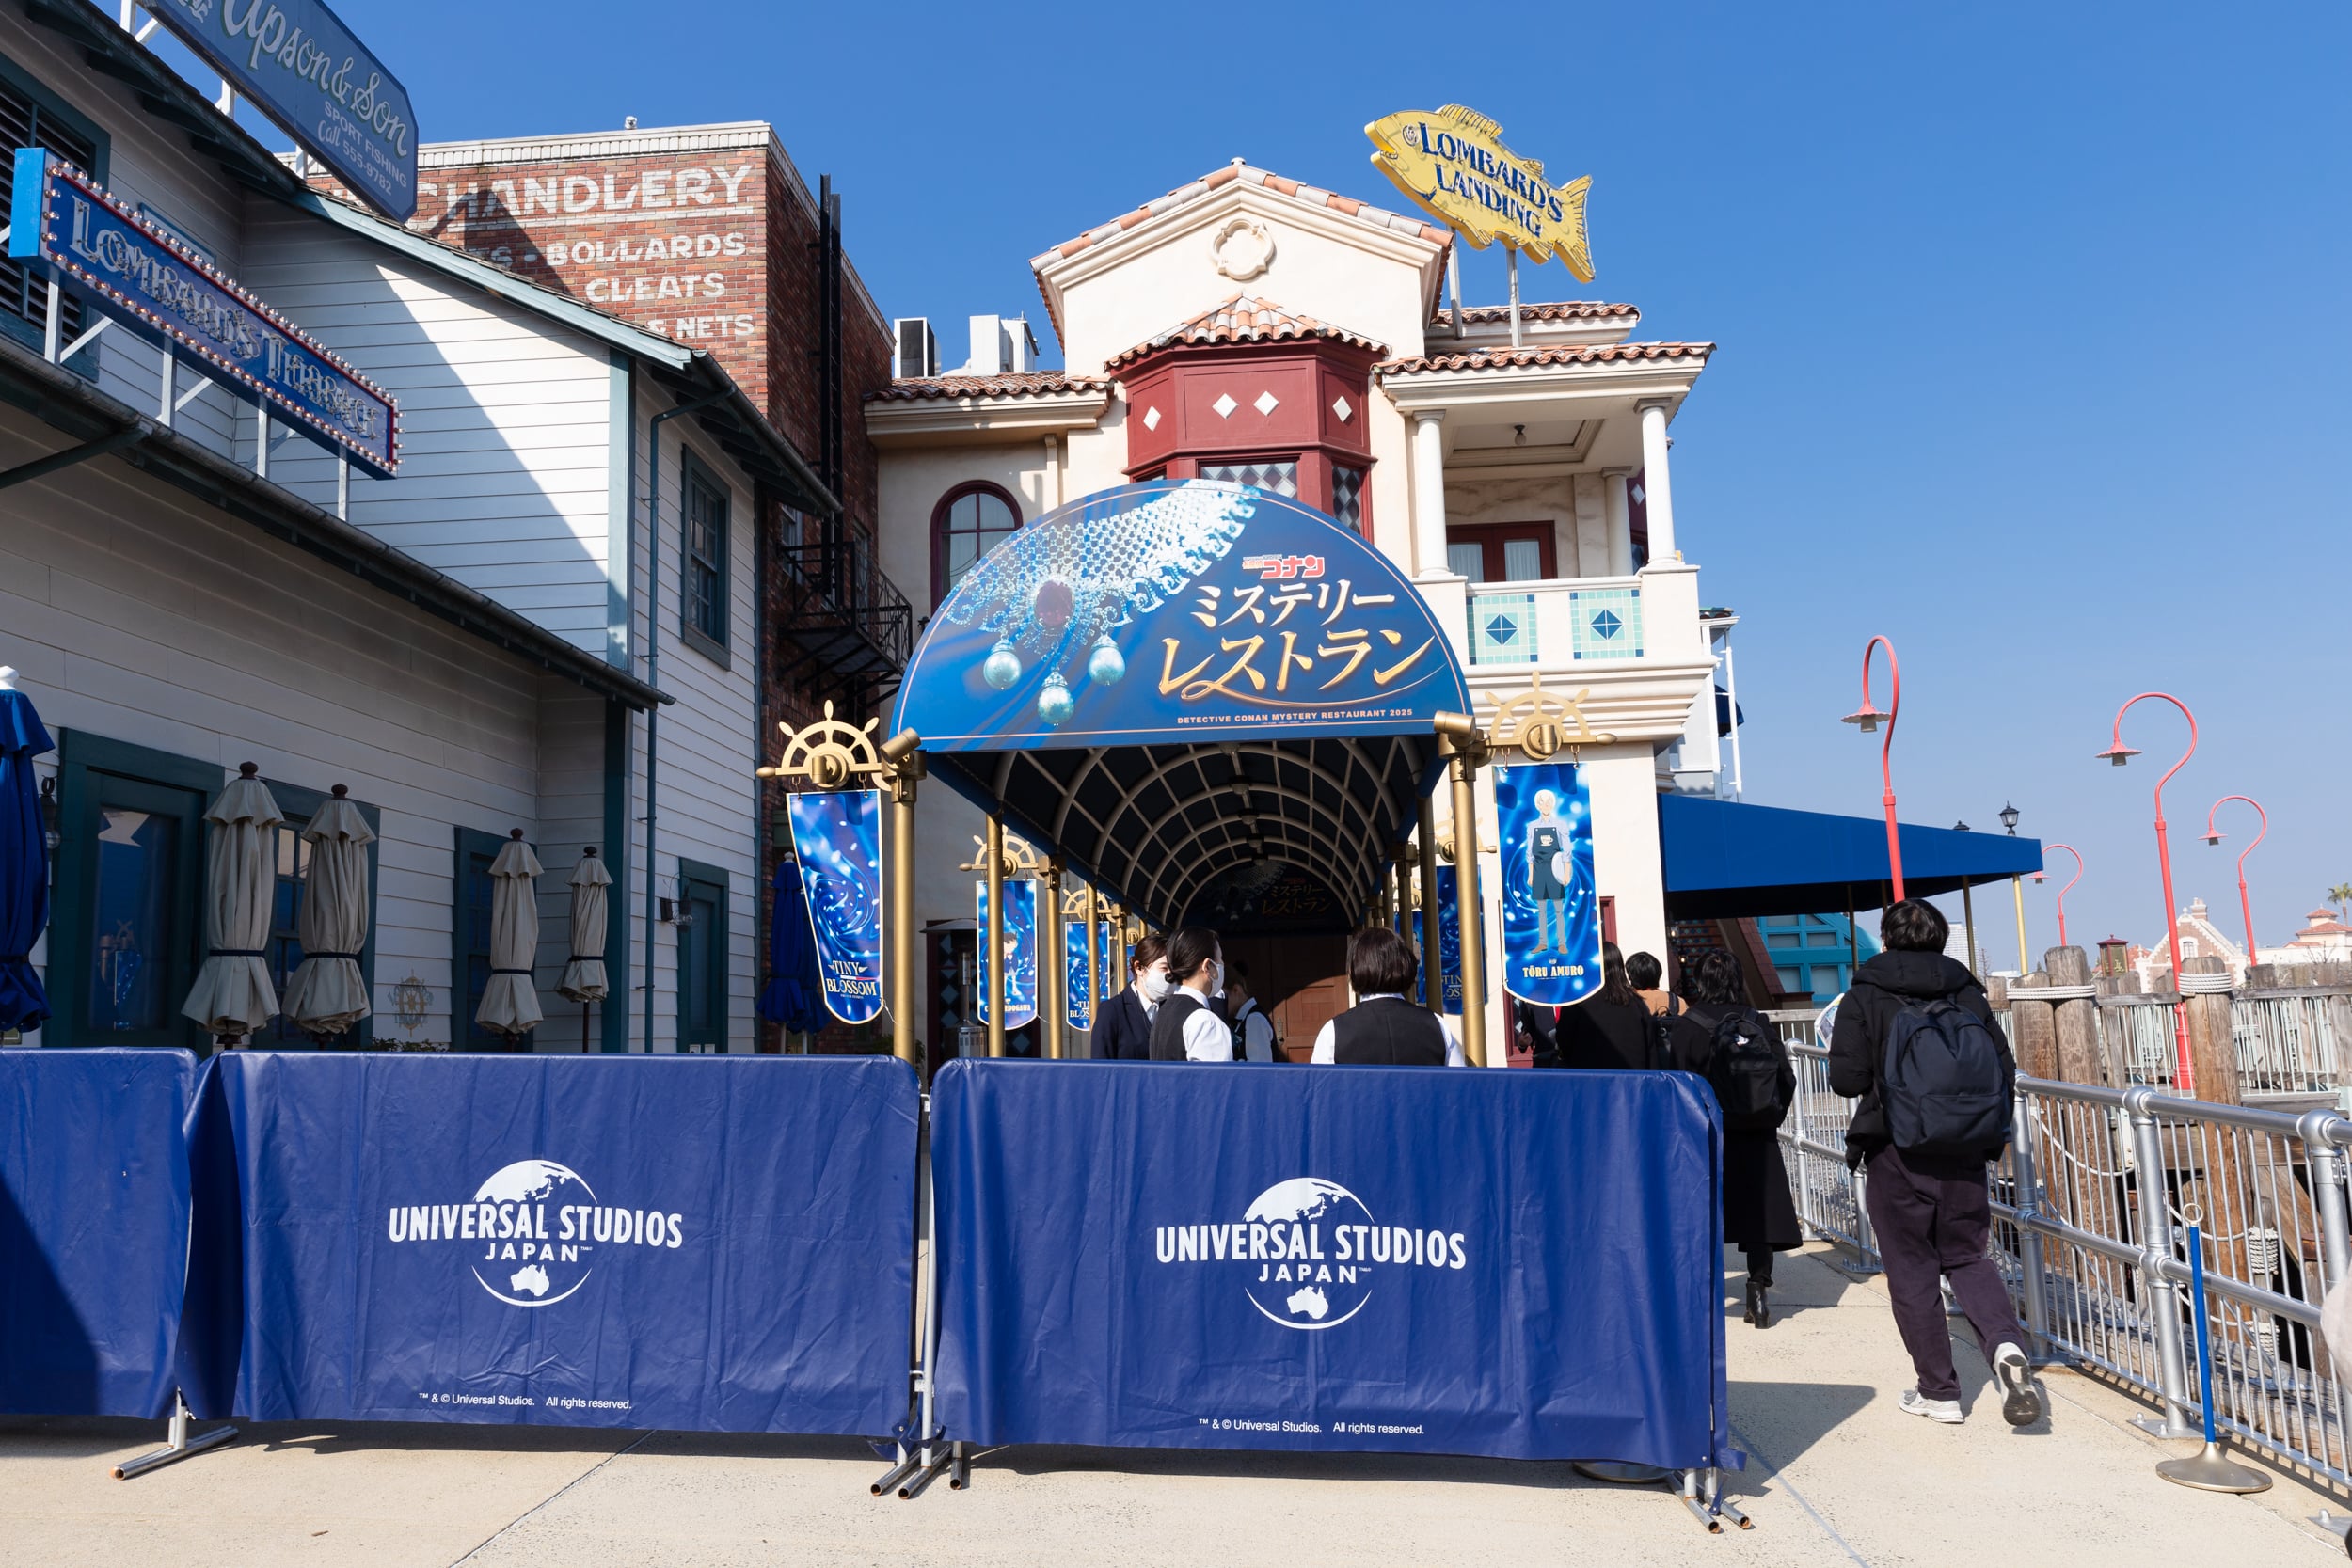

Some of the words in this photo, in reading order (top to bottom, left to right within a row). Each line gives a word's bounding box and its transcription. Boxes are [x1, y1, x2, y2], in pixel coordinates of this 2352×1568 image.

[331, 57, 354, 104] &
[350, 73, 407, 157] Son
[318, 120, 340, 146] Call
[342, 140, 392, 196] 555-9782
[324, 101, 363, 145] SPORT
[365, 139, 407, 188] FISHING
[1418, 122, 1564, 223] LOMBARD'S
[1434, 164, 1544, 238] LANDING
[547, 232, 747, 267] BOLLARDS
[585, 273, 726, 303] CLEATS
[676, 314, 755, 339] NETS
[1190, 579, 1396, 629] ミステリー
[1158, 628, 1437, 701] レストラン
[1177, 715, 1232, 724] DETECTIVE
[1234, 714, 1268, 722] CONAN
[1271, 712, 1318, 721] MYSTERY
[1321, 709, 1387, 720] RESTAURANT
[1390, 708, 1413, 717] 2025
[833, 960, 860, 975] TINY
[1550, 965, 1584, 977] AMURO
[826, 978, 877, 996] BLOSSOM
[389, 1203, 548, 1243] UNIVERSAL
[559, 1205, 683, 1249] STUDIOS
[485, 1243, 578, 1262] JAPAN
[1156, 1223, 1325, 1263] UNIVERSAL
[1335, 1225, 1467, 1270] STUDIOS
[1258, 1264, 1357, 1284] JAPAN
[431, 1395, 438, 1403] &
[452, 1394, 496, 1405] Universal
[498, 1395, 535, 1406] Studios.
[546, 1396, 558, 1407] All
[561, 1396, 586, 1410] rights
[588, 1398, 632, 1409] reserved.
[1212, 1419, 1220, 1430] &
[1233, 1419, 1279, 1432] Universal
[1282, 1420, 1322, 1433] Studios.
[1333, 1422, 1345, 1433] All
[1348, 1421, 1375, 1435] rights
[1378, 1423, 1424, 1434] reserved.
